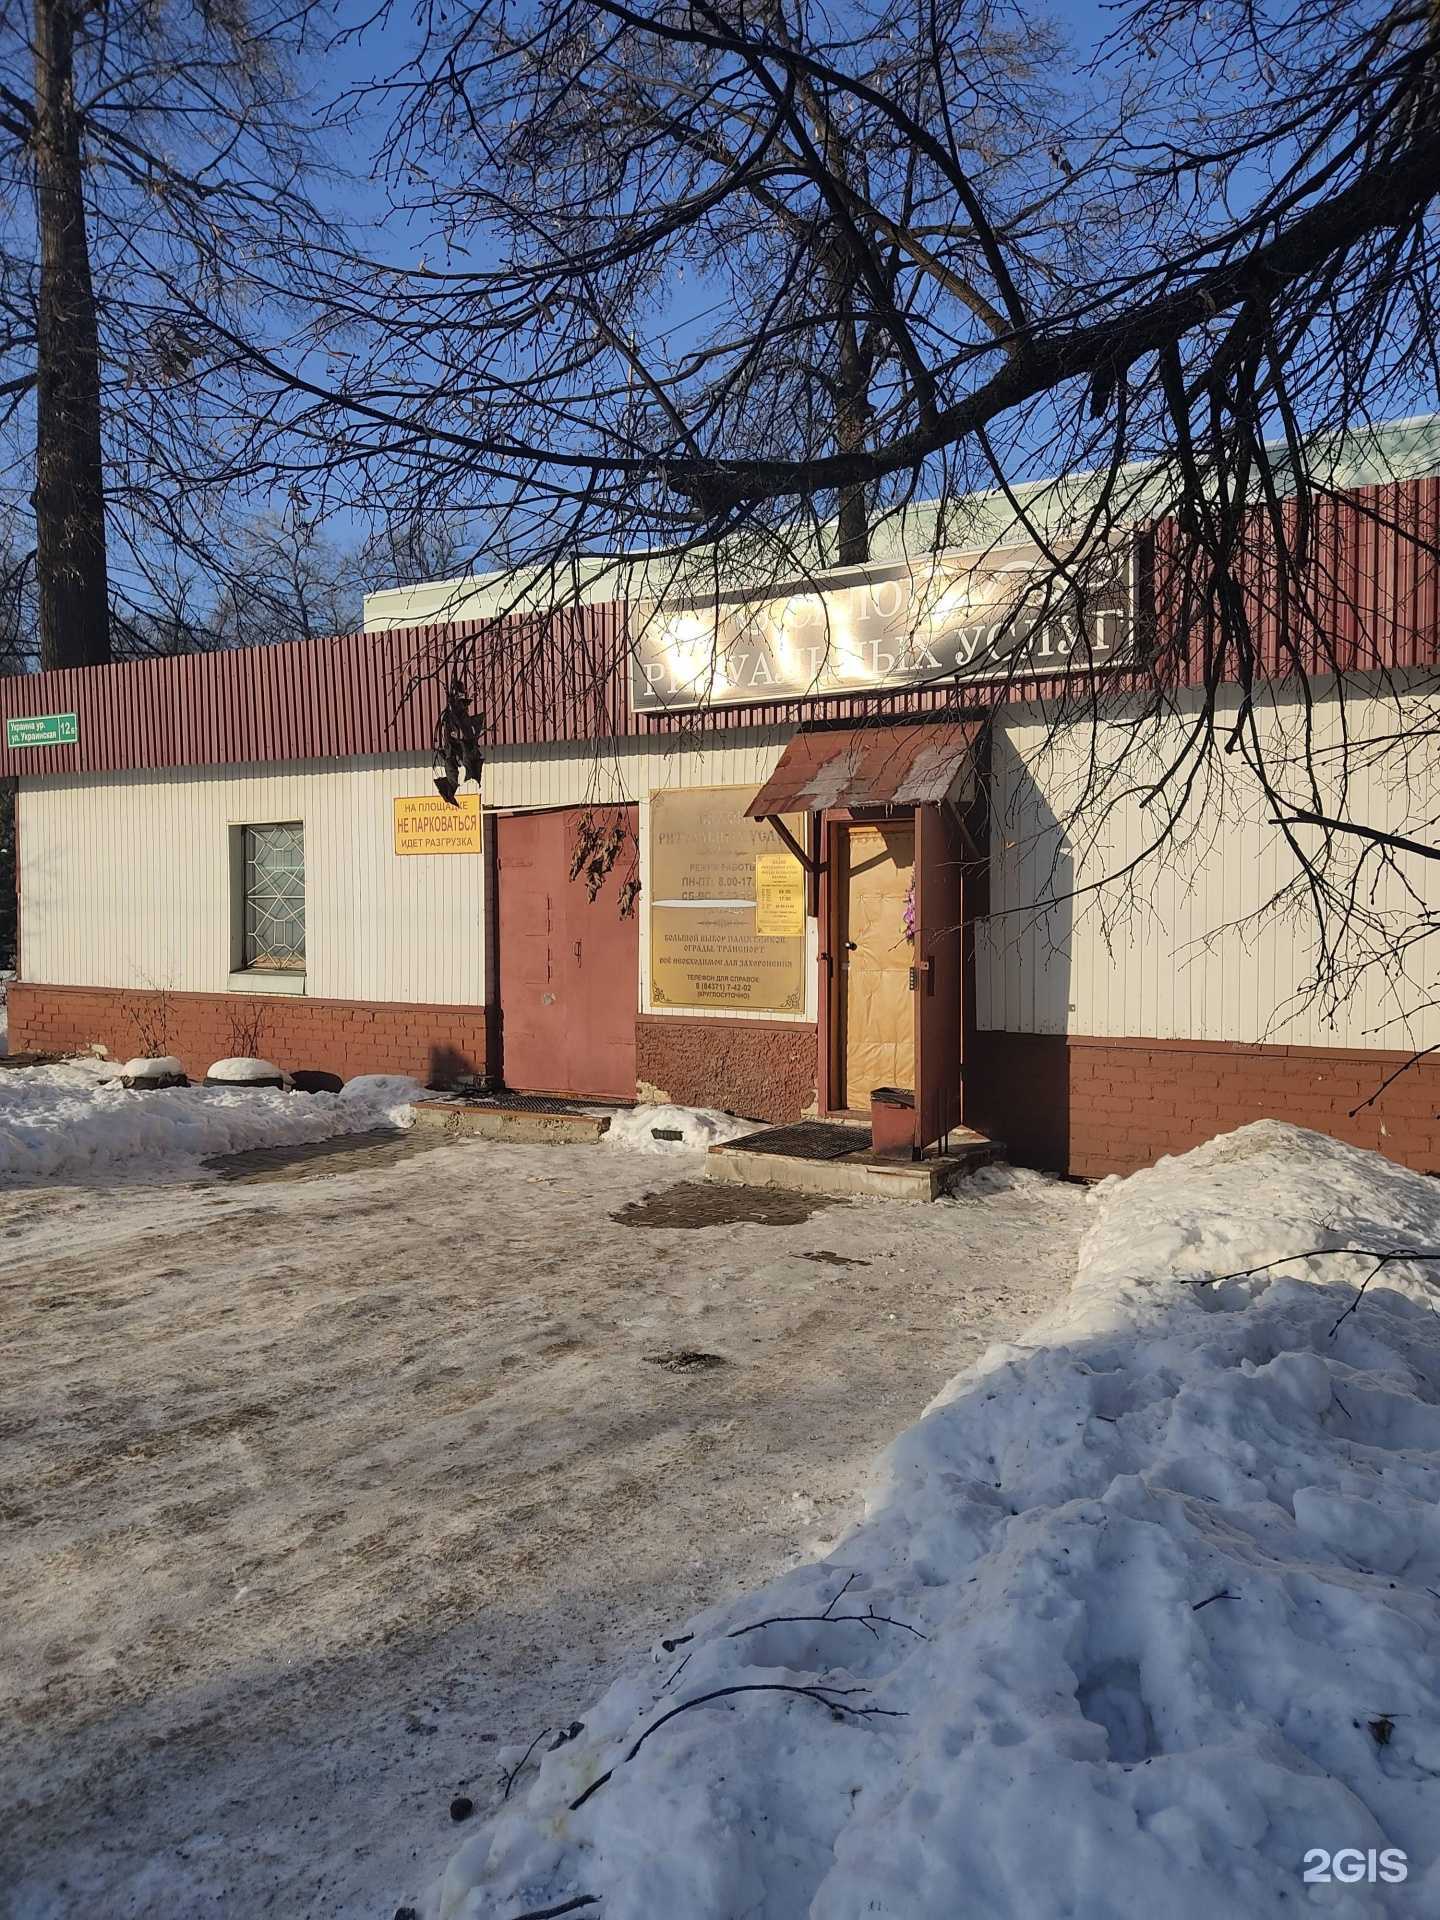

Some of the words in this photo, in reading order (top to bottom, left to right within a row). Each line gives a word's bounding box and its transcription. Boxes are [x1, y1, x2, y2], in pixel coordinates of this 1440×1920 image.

[643, 636, 943, 696] РИУАЛЬНЫХ
[955, 609, 1125, 667] УСЛУГ
[10, 722, 35, 733] Украина
[20, 731, 57, 742] Украинская
[404, 803, 416, 813] НА
[418, 801, 469, 812] ПЛОЩАДКЕ
[397, 817, 409, 833] НЕ
[411, 815, 477, 833] ПАРКОВАТЬСЯ
[401, 839, 422, 849] ИДЕТ
[425, 837, 473, 848] РАЗГРУЗКА
[664, 934, 699, 943] БОЛЬШОЙ
[695, 982, 700, 990] 8
[726, 983, 752, 992] 7-42-02
